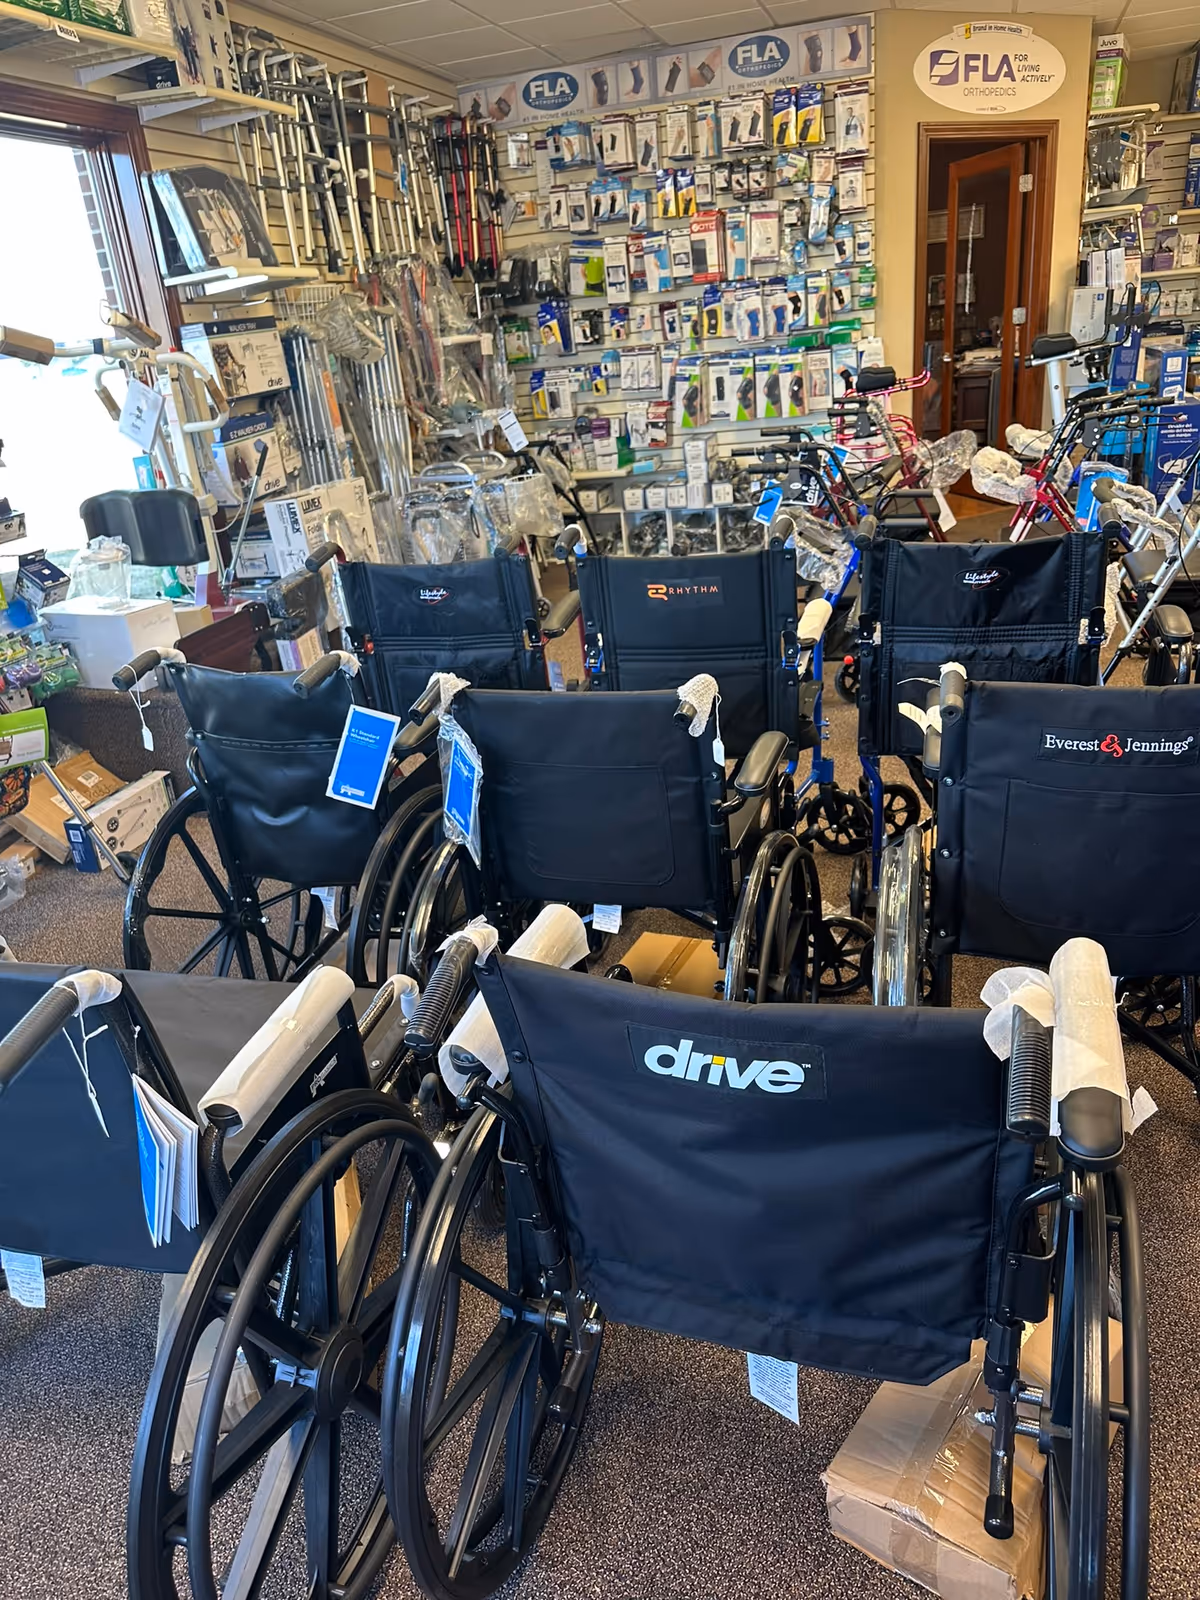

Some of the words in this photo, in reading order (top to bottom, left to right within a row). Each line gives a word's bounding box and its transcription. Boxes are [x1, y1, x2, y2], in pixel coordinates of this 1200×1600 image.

[973, 24, 987, 32] Brand
[994, 24, 1007, 32] Home
[1008, 26, 1022, 34] Health
[1100, 39, 1118, 47] Juvo
[736, 41, 781, 65] FLA
[1014, 54, 1028, 62] FOR
[738, 62, 782, 73] ORTHOPEDICS
[964, 54, 1016, 82] FLA
[1017, 64, 1040, 72] LIVING
[155, 81, 171, 89] drive
[529, 77, 571, 98] FLA
[746, 80, 766, 88] HOME
[963, 87, 1016, 97] ORTHOPEDICS
[267, 377, 284, 388] drive
[264, 479, 280, 491] drive
[806, 476, 817, 502] drive
[301, 497, 322, 514] LUMEX
[287, 502, 301, 534] LUMEX
[965, 570, 999, 581] Lifestyle
[420, 587, 447, 598] Lifestyle
[669, 585, 718, 595] RHYTHM
[359, 729, 380, 740] Standard
[1044, 734, 1099, 751] Everest
